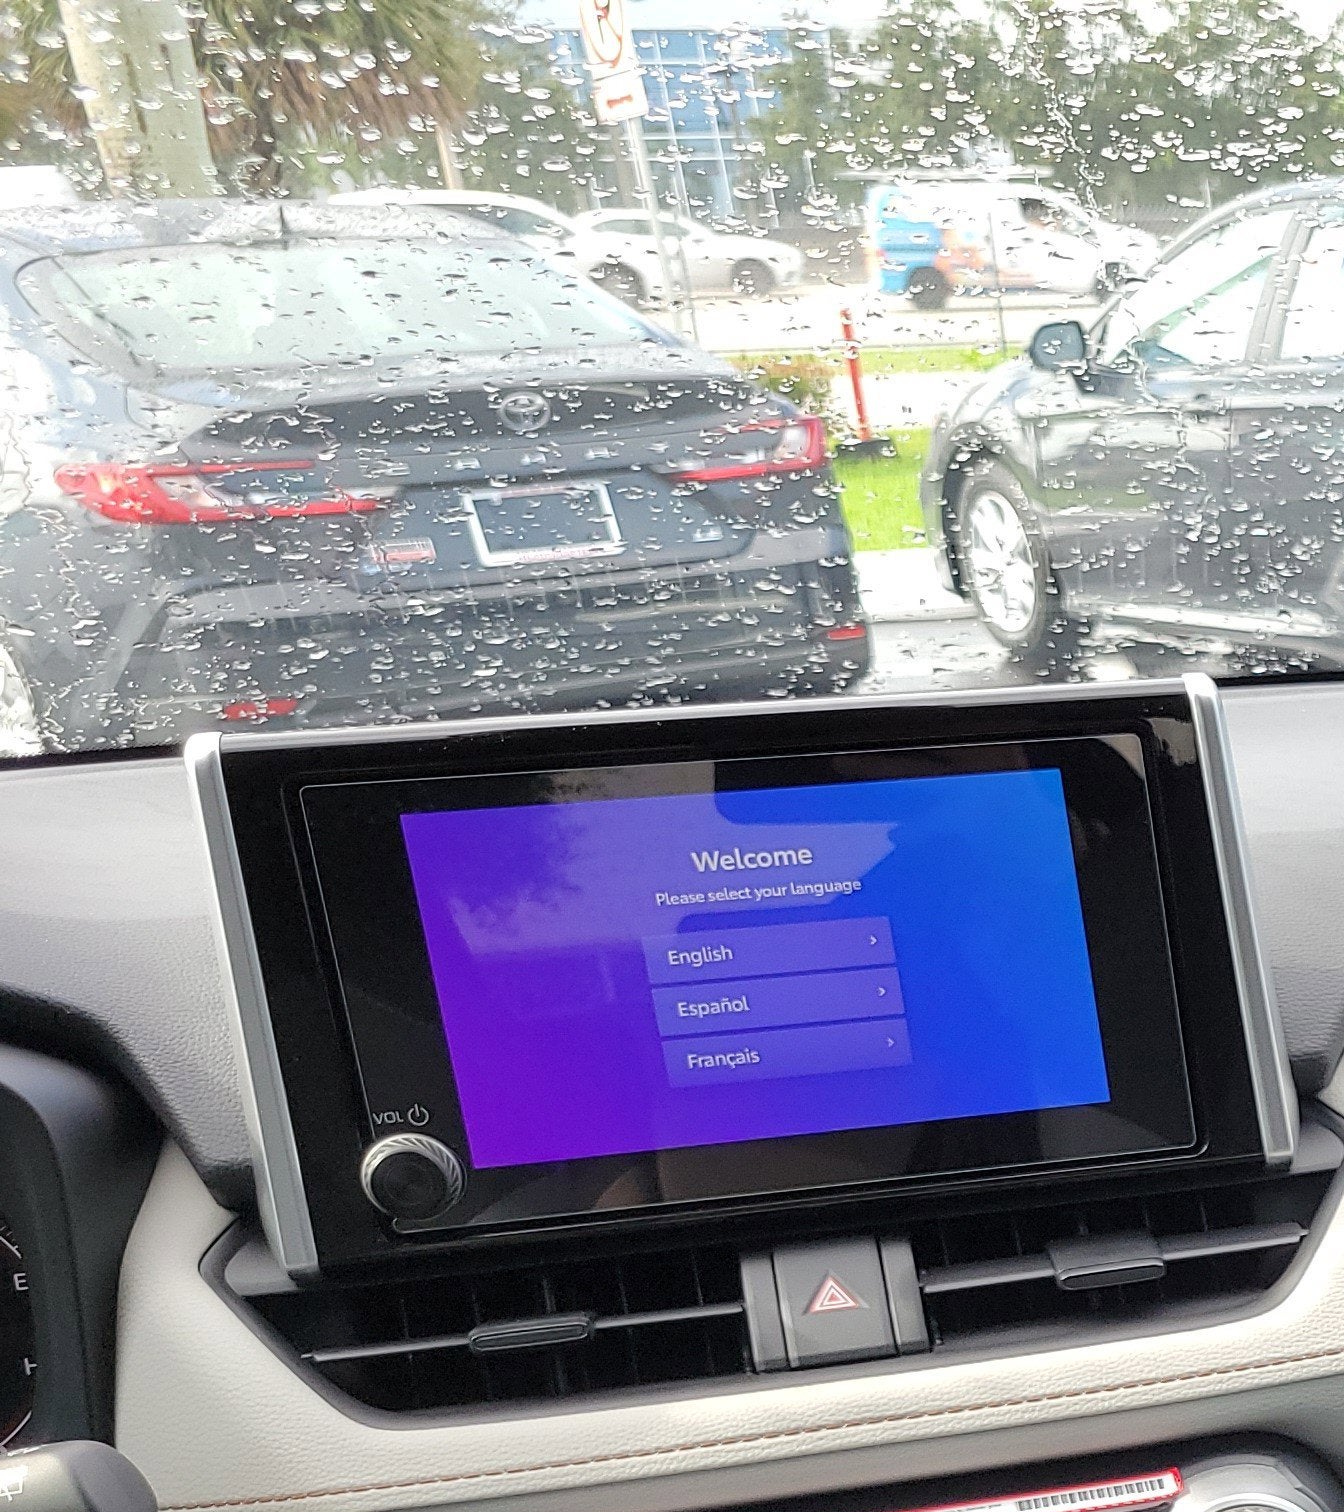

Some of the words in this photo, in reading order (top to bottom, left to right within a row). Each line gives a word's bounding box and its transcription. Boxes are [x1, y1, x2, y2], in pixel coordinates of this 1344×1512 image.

[691, 848, 813, 872] Welcome
[656, 892, 705, 906] Please
[707, 887, 752, 902] select
[754, 886, 787, 901] your
[790, 880, 861, 896] language
[668, 945, 733, 967] English
[678, 995, 750, 1018] Español
[687, 1047, 761, 1069] Français
[372, 1110, 404, 1125] VOL
[13, 1272, 29, 1290] E
